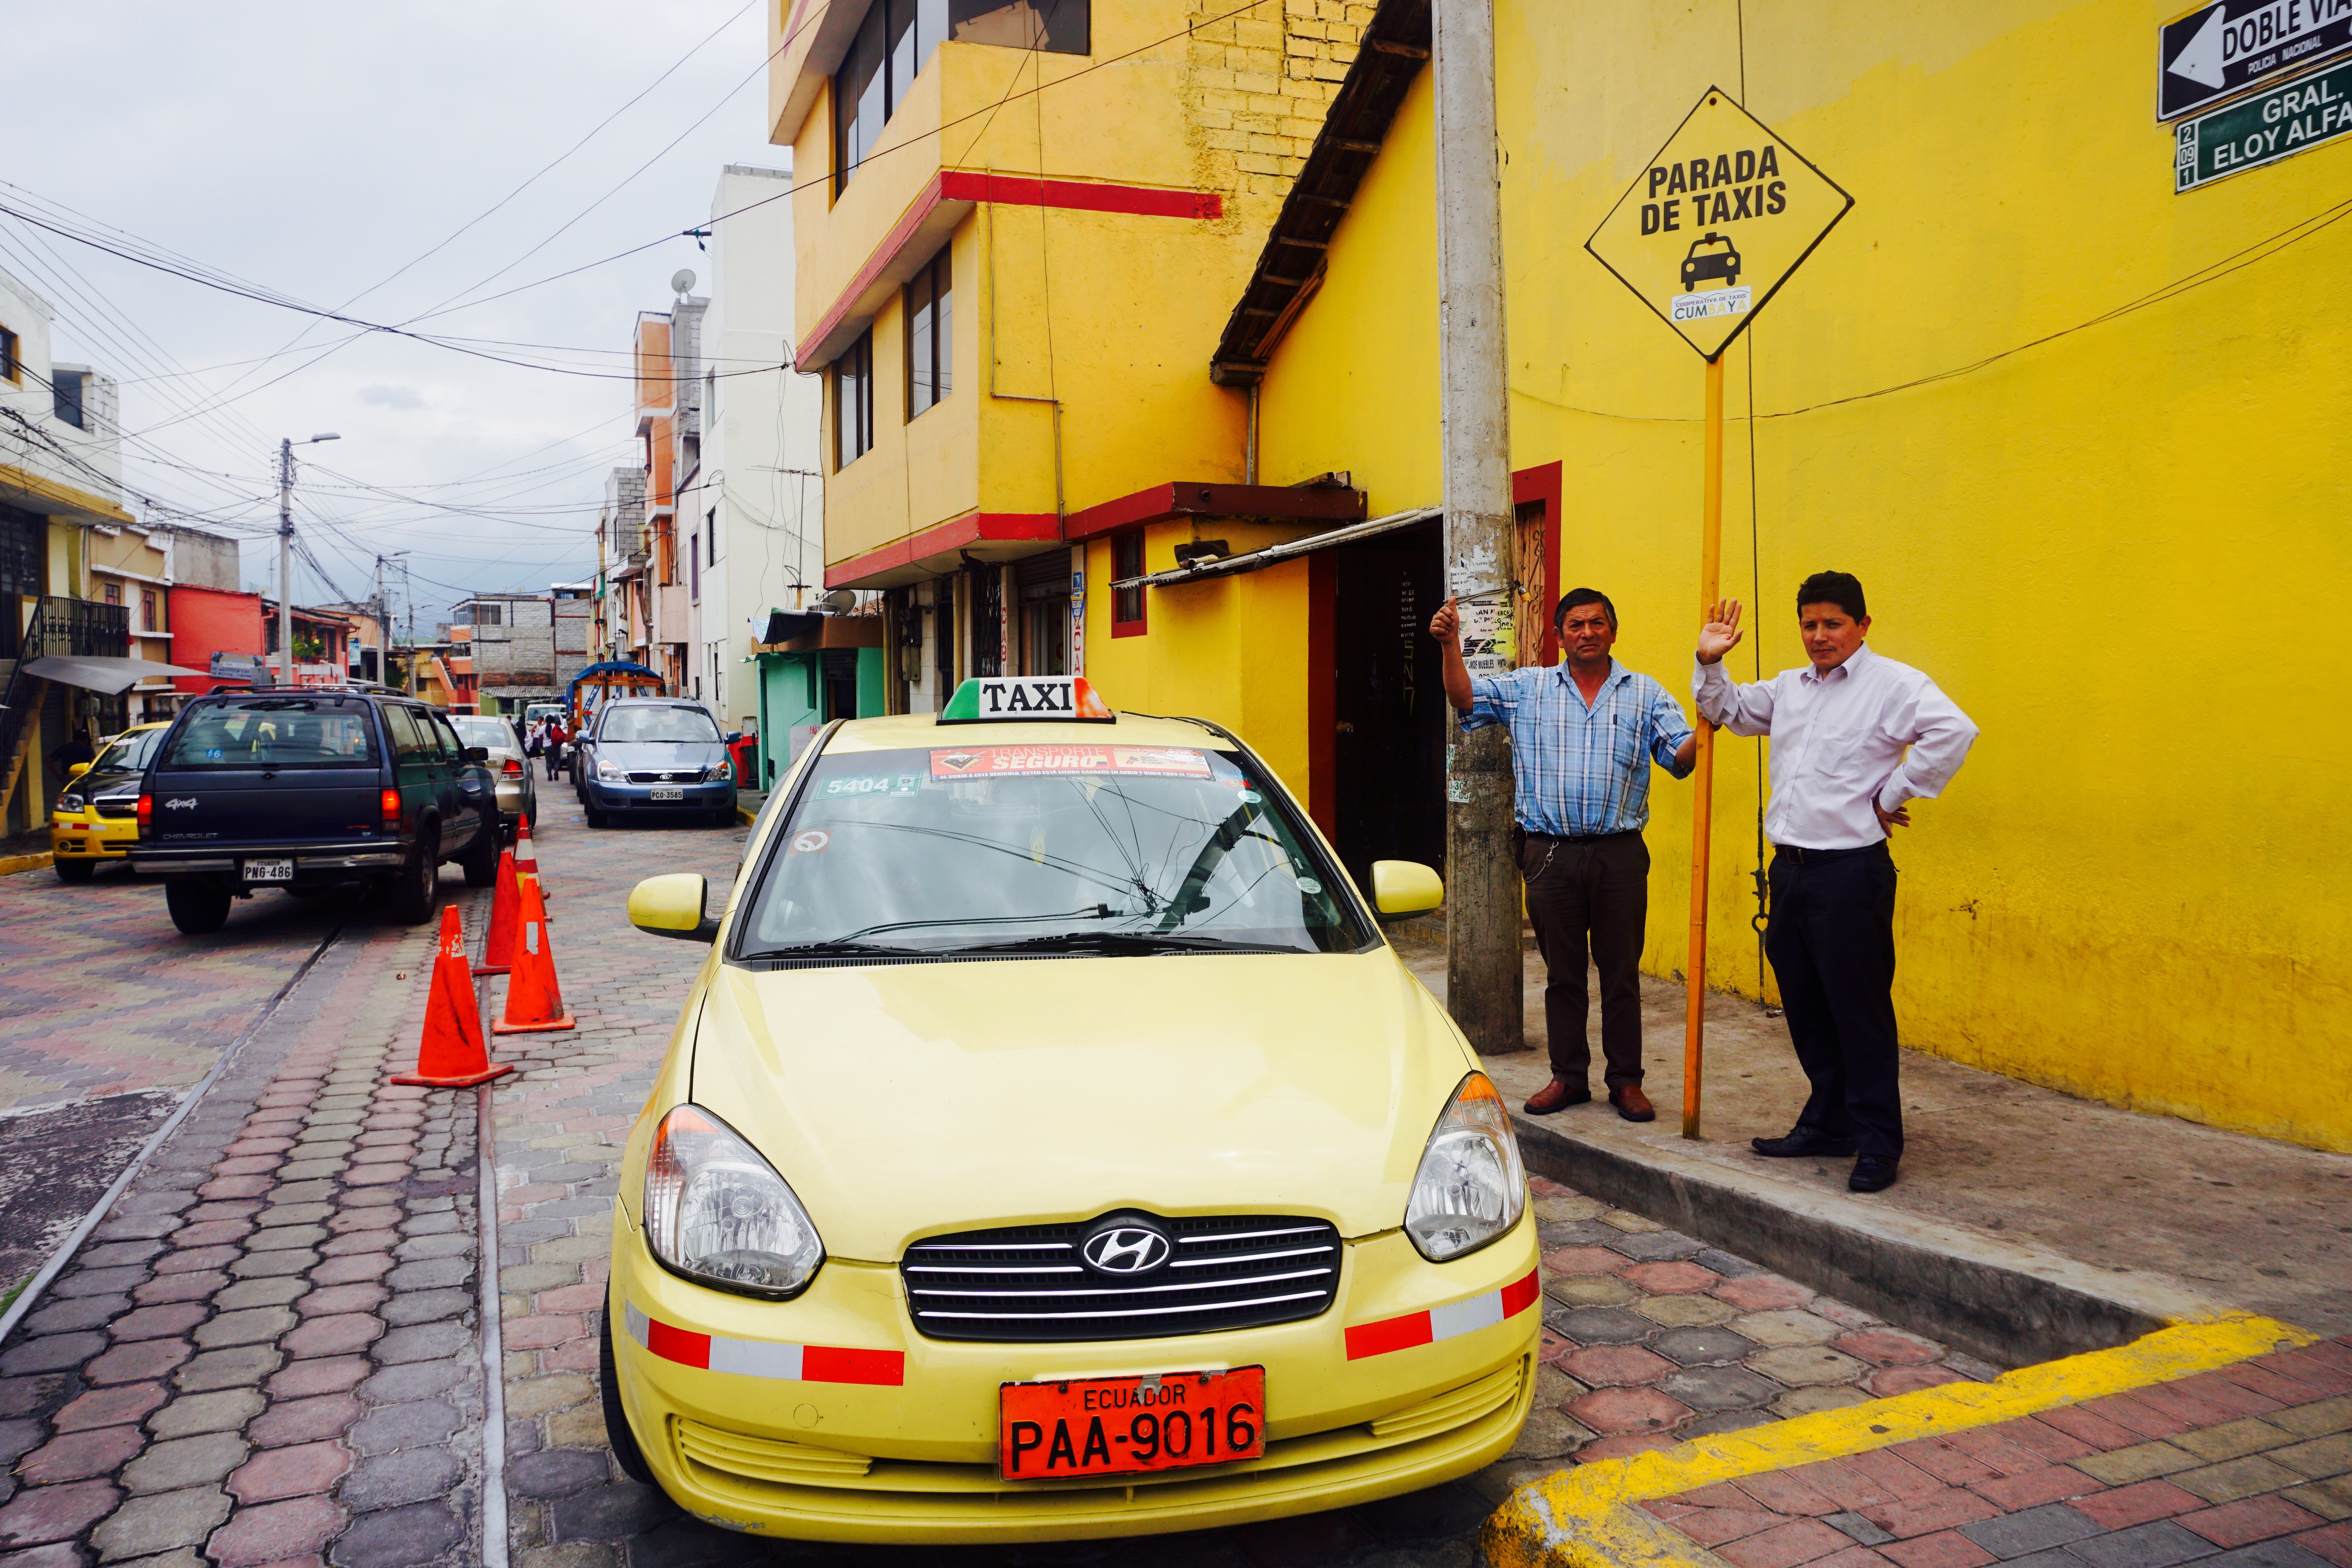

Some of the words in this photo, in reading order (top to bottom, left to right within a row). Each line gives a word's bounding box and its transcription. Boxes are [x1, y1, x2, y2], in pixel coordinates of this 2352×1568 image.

[2223, 1, 2301, 62] DOBLE
[2249, 53, 2276, 75] POLICIA
[2282, 35, 2322, 61] NACIONAL
[2263, 80, 2343, 123] GRAL.
[2183, 127, 2191, 143] 2
[2214, 125, 2281, 169] ELOY
[2286, 101, 2352, 145] ALFA
[2180, 146, 2194, 163] 09
[1649, 145, 1779, 198] PARADA
[2183, 169, 2189, 184] 1
[1641, 200, 1680, 236] DE
[1692, 181, 1786, 227] TAXIS
[1675, 299, 1747, 319] CUMBAYA
[1676, 298, 1717, 307] COOPERATIVA
[1478, 659, 1494, 670] MUEBLES
[983, 683, 1072, 711] TAXI
[991, 747, 1104, 757] TRANSPORTE
[992, 755, 1098, 769] SEGURO
[827, 778, 889, 793] 5404
[165, 798, 199, 811] 4x4
[245, 866, 290, 878] PNG-486
[1085, 1384, 1185, 1410] ECUADOR
[1011, 1402, 1255, 1472] PAA-9016
